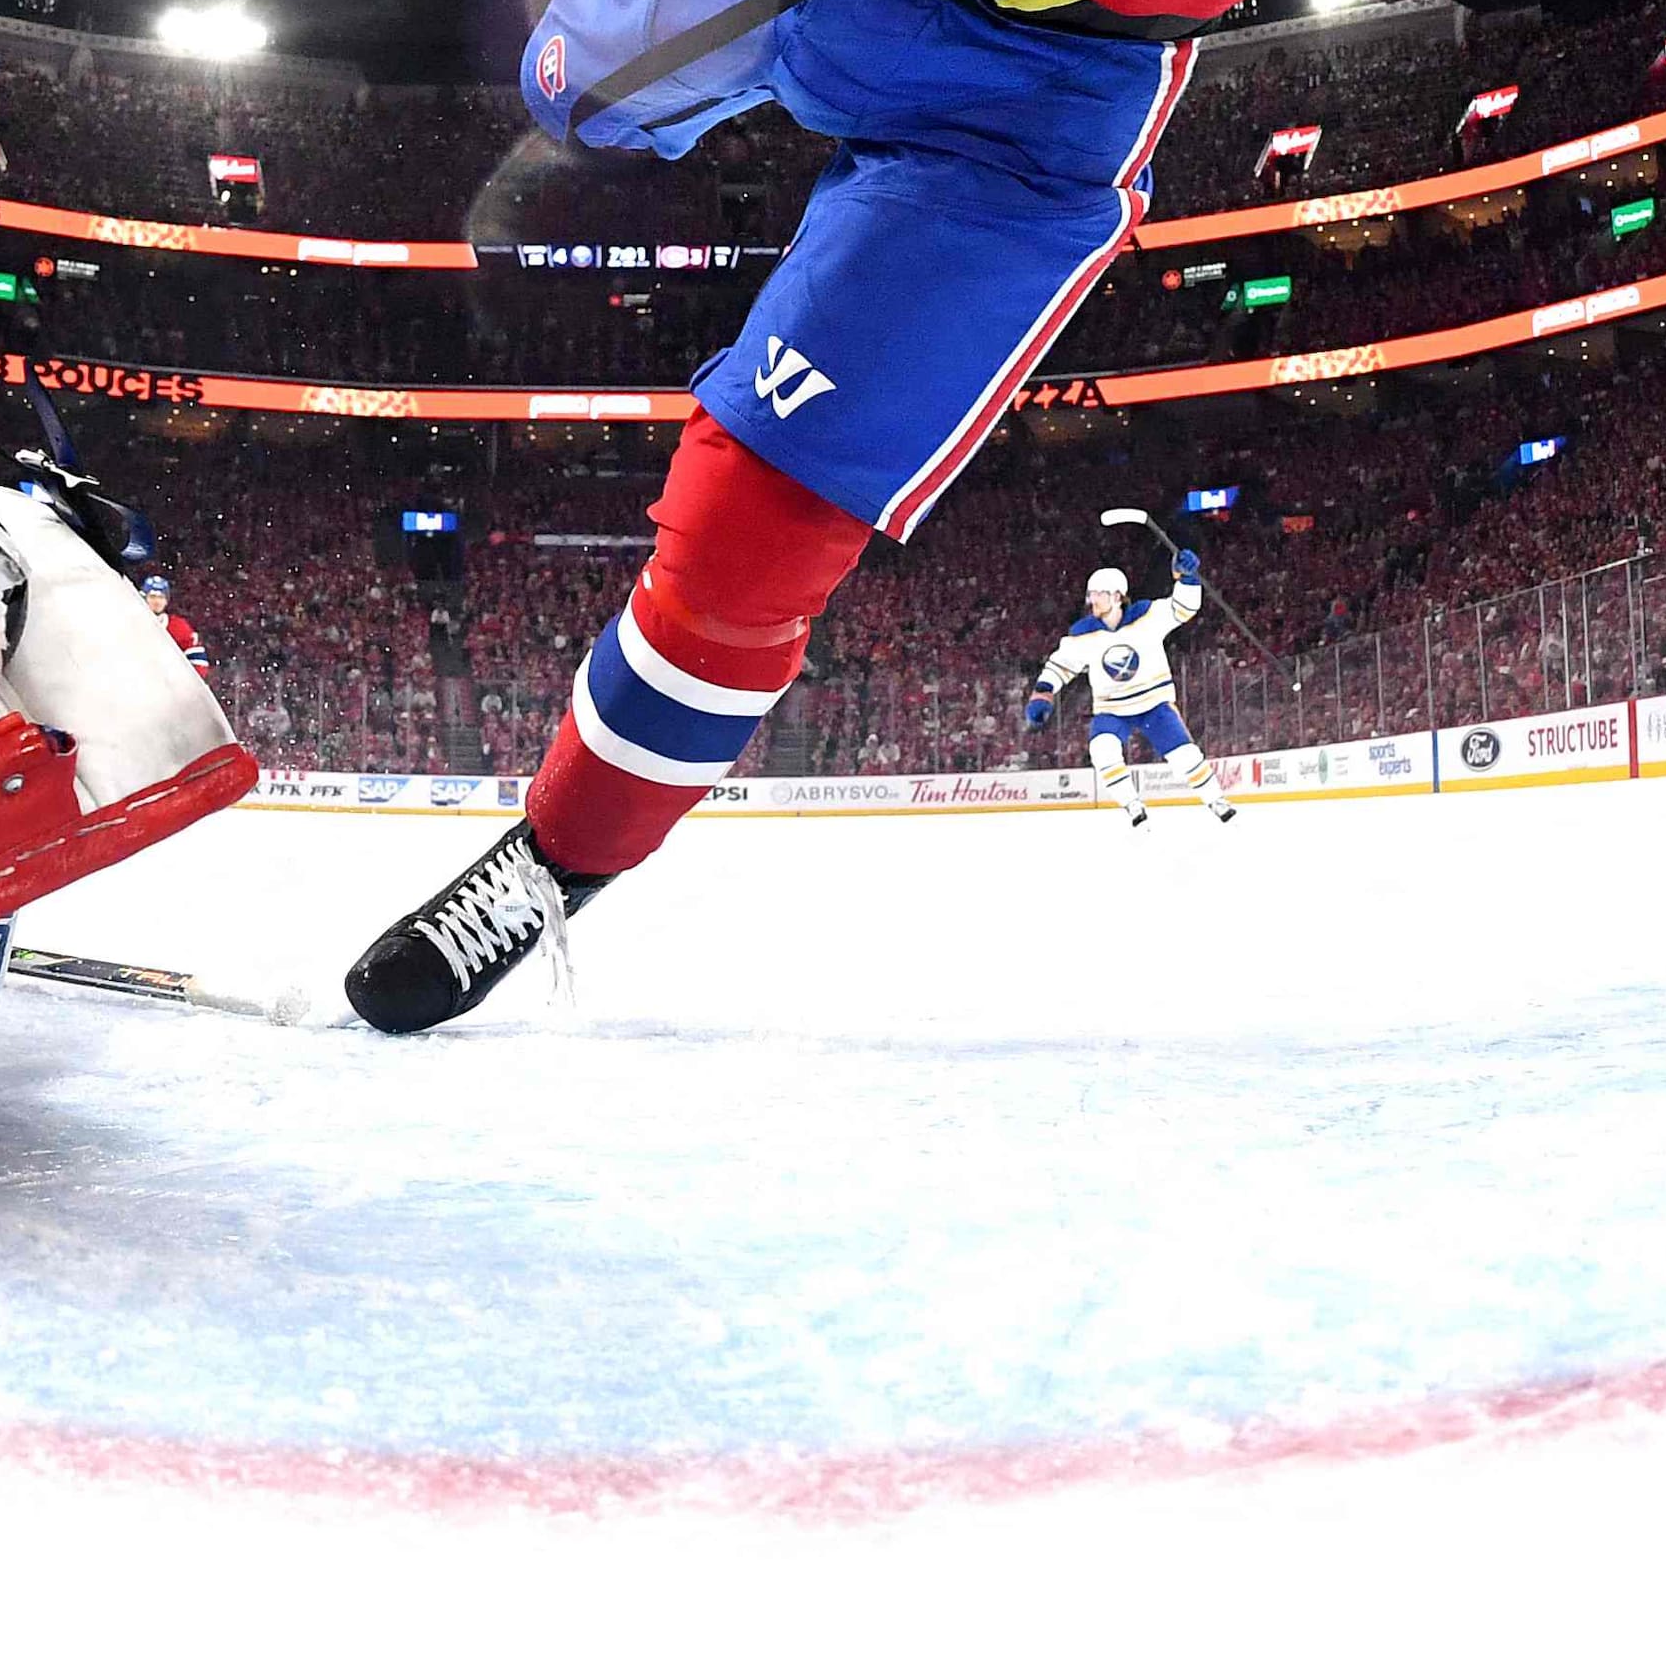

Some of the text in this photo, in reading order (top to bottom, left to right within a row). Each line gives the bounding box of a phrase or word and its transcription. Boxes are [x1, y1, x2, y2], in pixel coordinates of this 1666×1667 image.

[1465, 734, 1496, 764] Ford
[1527, 717, 1619, 758] STRUCTUBE
[1368, 741, 1396, 762] sports
[1378, 755, 1413, 781] experts
[359, 780, 401, 800] SAP
[431, 780, 473, 800] SAP
[795, 785, 889, 801] ABRYSVO
[908, 777, 1029, 803] Tim Hortons
